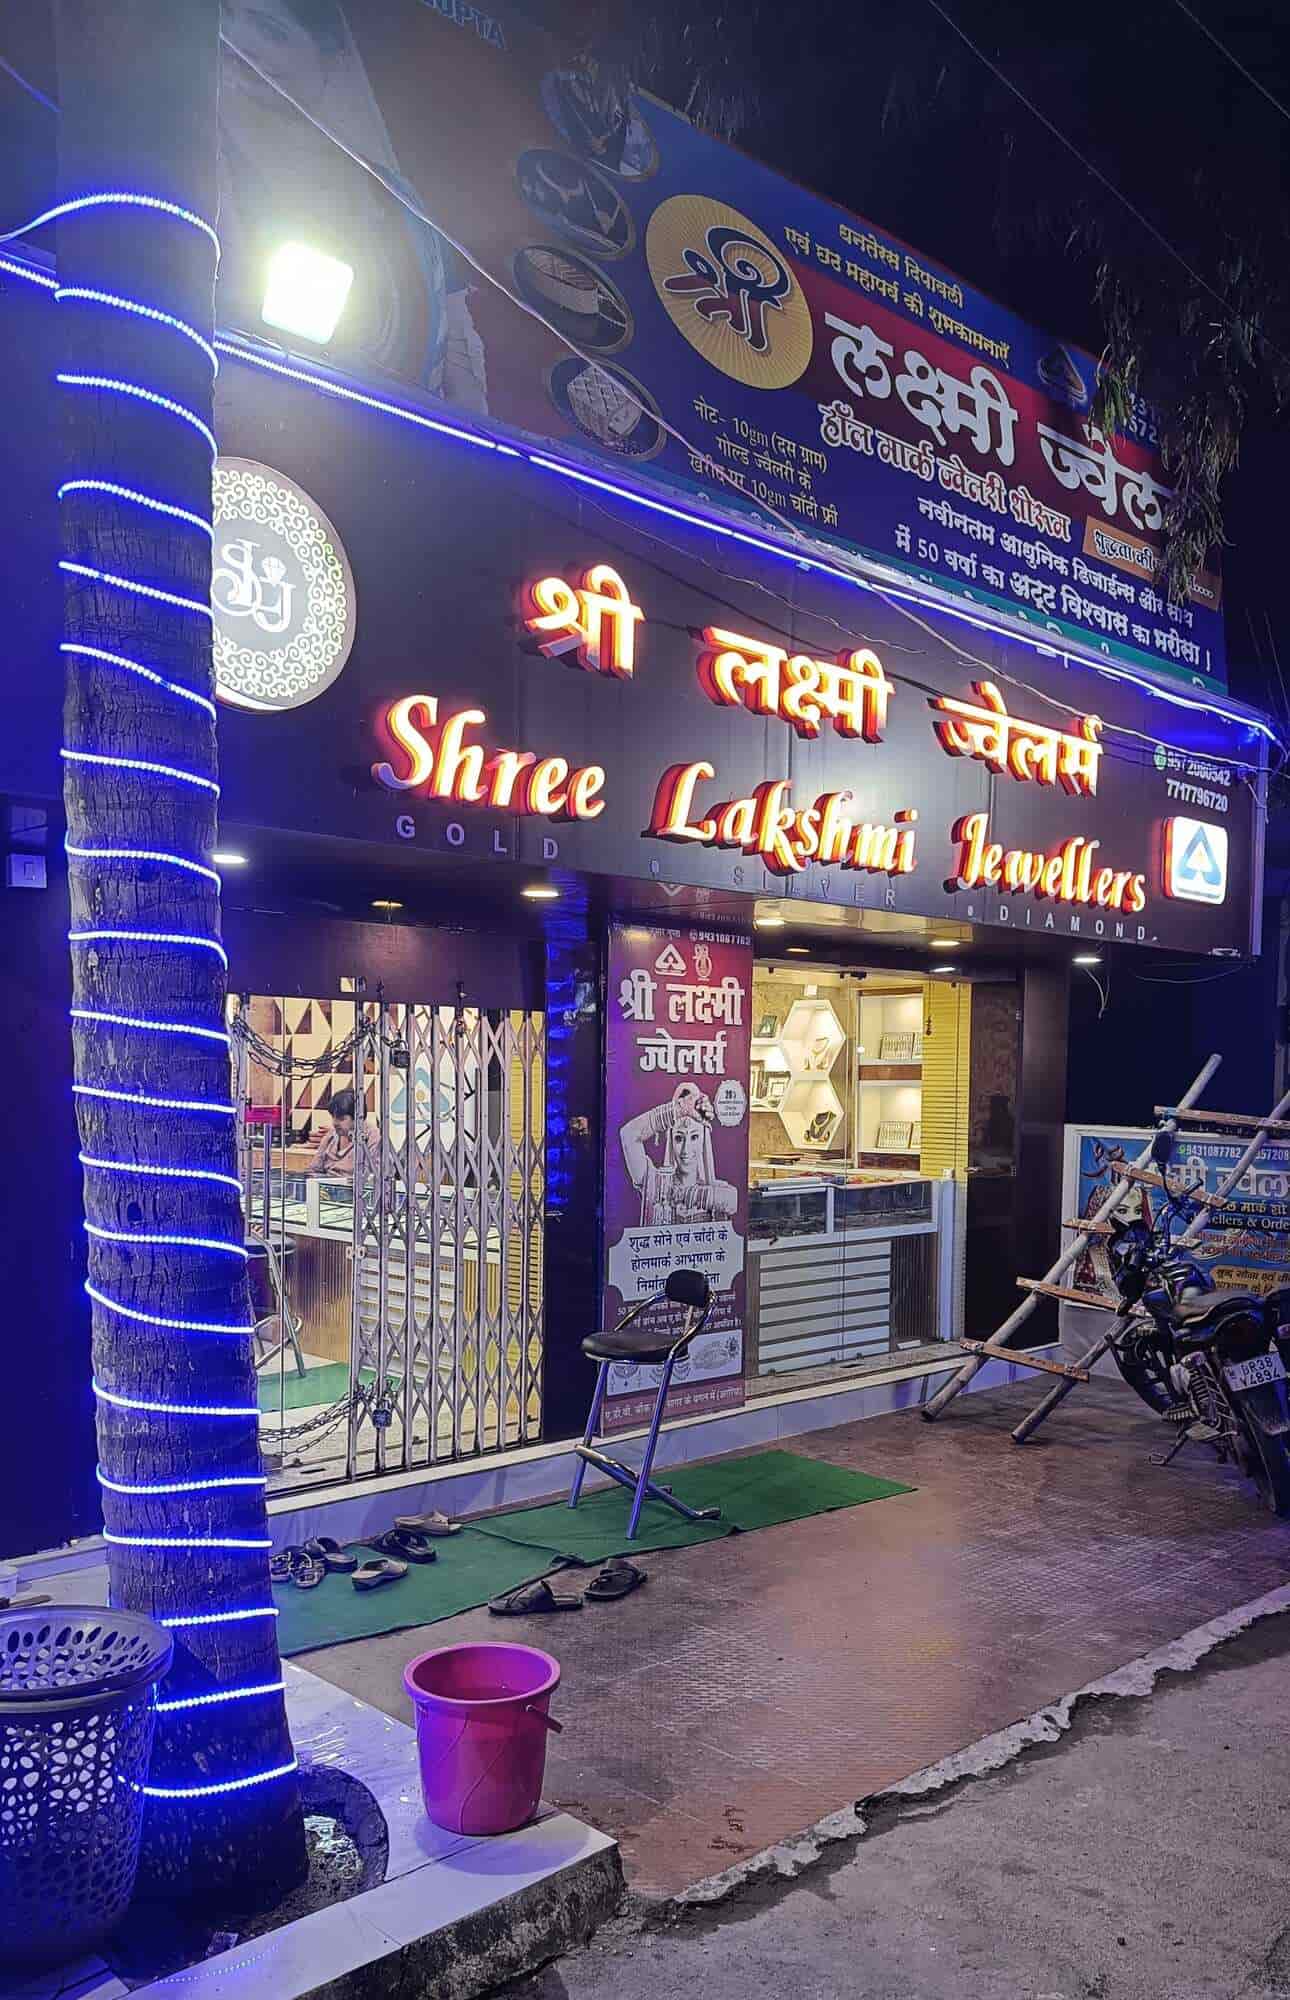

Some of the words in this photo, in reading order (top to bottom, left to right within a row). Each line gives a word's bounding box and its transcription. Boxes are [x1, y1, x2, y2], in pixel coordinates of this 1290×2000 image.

[784, 226, 809, 256] एवं
[816, 243, 842, 272] छठ
[846, 260, 900, 304] महापर्व
[903, 291, 924, 317] की
[840, 224, 900, 271] धनतेरस
[824, 312, 1018, 467] लक्ष्मी
[733, 416, 769, 447] 10gm
[876, 430, 935, 481] मार्क
[715, 432, 750, 465] गोल्ड
[798, 468, 813, 490] के
[751, 479, 787, 508] 10gm
[821, 503, 839, 528] फ्री
[917, 496, 996, 546] नवीनतम
[1000, 532, 1069, 577] आधुनिक
[1139, 586, 1164, 617] और
[1136, 547, 1155, 573] की
[895, 524, 911, 552] में
[917, 538, 939, 563] 50
[981, 563, 1005, 590] का
[1060, 583, 1129, 637] विश्वास
[1131, 622, 1151, 646] का
[525, 563, 644, 679] श्री
[699, 625, 894, 743] लक्ष्मी
[928, 681, 1105, 798] ज्वेलर्स
[372, 694, 606, 822] Shree
[646, 761, 919, 877] Lakshmi
[945, 812, 1147, 915] Jewellers
[396, 813, 560, 861] GOLD
[617, 968, 658, 1022] श्री
[666, 976, 746, 1026] लक्ष्मी
[636, 1028, 729, 1075] ज्वेलर्स
[628, 1236, 650, 1253] शुद्ध
[653, 1229, 673, 1248] सोने
[676, 1230, 690, 1248] एवं
[718, 1226, 728, 1242] के
[1208, 1213, 1243, 1226] ellers
[1247, 1217, 1258, 1229] &
[674, 1252, 712, 1269] आभूषण
[715, 1247, 726, 1263] के
